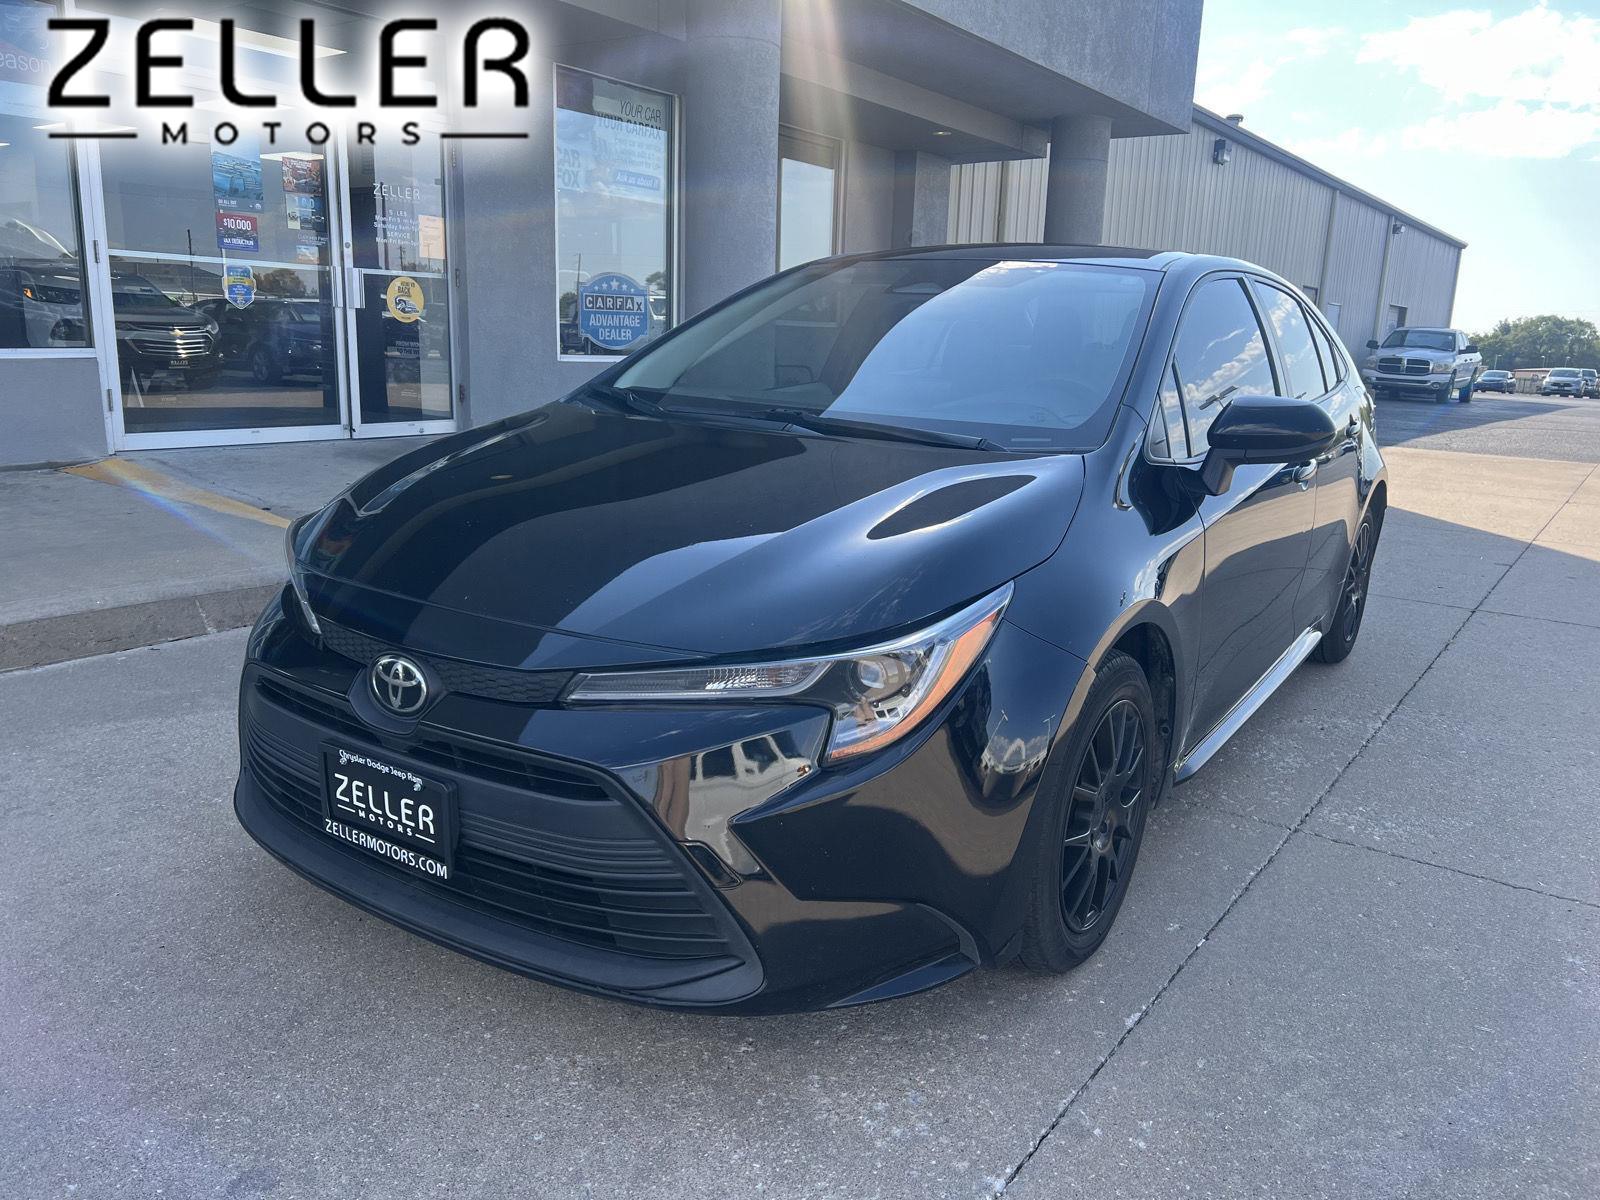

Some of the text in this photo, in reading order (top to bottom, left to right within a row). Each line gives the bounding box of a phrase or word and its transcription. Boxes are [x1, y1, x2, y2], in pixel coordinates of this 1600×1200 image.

[620, 100, 662, 124] YOUR CAR
[373, 183, 420, 200] ZELLER
[388, 209, 407, 217] SLES
[585, 296, 643, 312] CARFAX
[589, 314, 641, 327] ADVANTAGE
[599, 328, 632, 341] DEALER
[339, 749, 423, 785] Chrysler Dodge Jeep Ram
[334, 773, 435, 835] ZELLER
[358, 809, 413, 836] MOTORS
[325, 818, 448, 880] ZELLERMOTORS.COM
